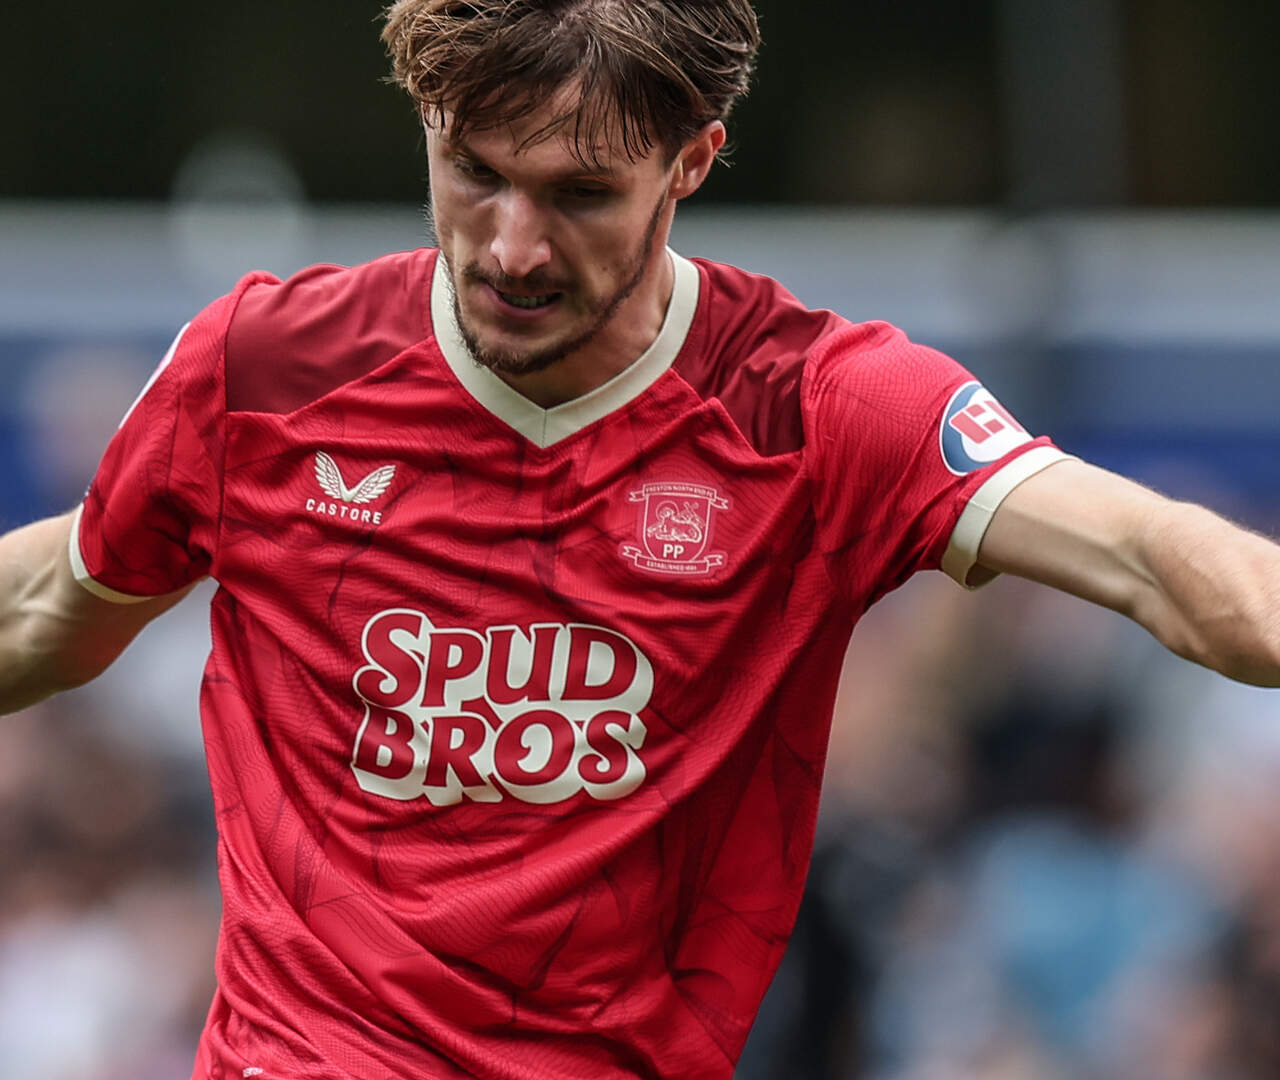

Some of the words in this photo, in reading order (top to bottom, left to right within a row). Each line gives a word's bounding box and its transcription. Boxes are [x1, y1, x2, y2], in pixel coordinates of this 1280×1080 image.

[306, 498, 383, 525] CASTORE
[663, 544, 685, 559] PP
[353, 608, 652, 708] SPUD
[351, 704, 648, 806] BROS
